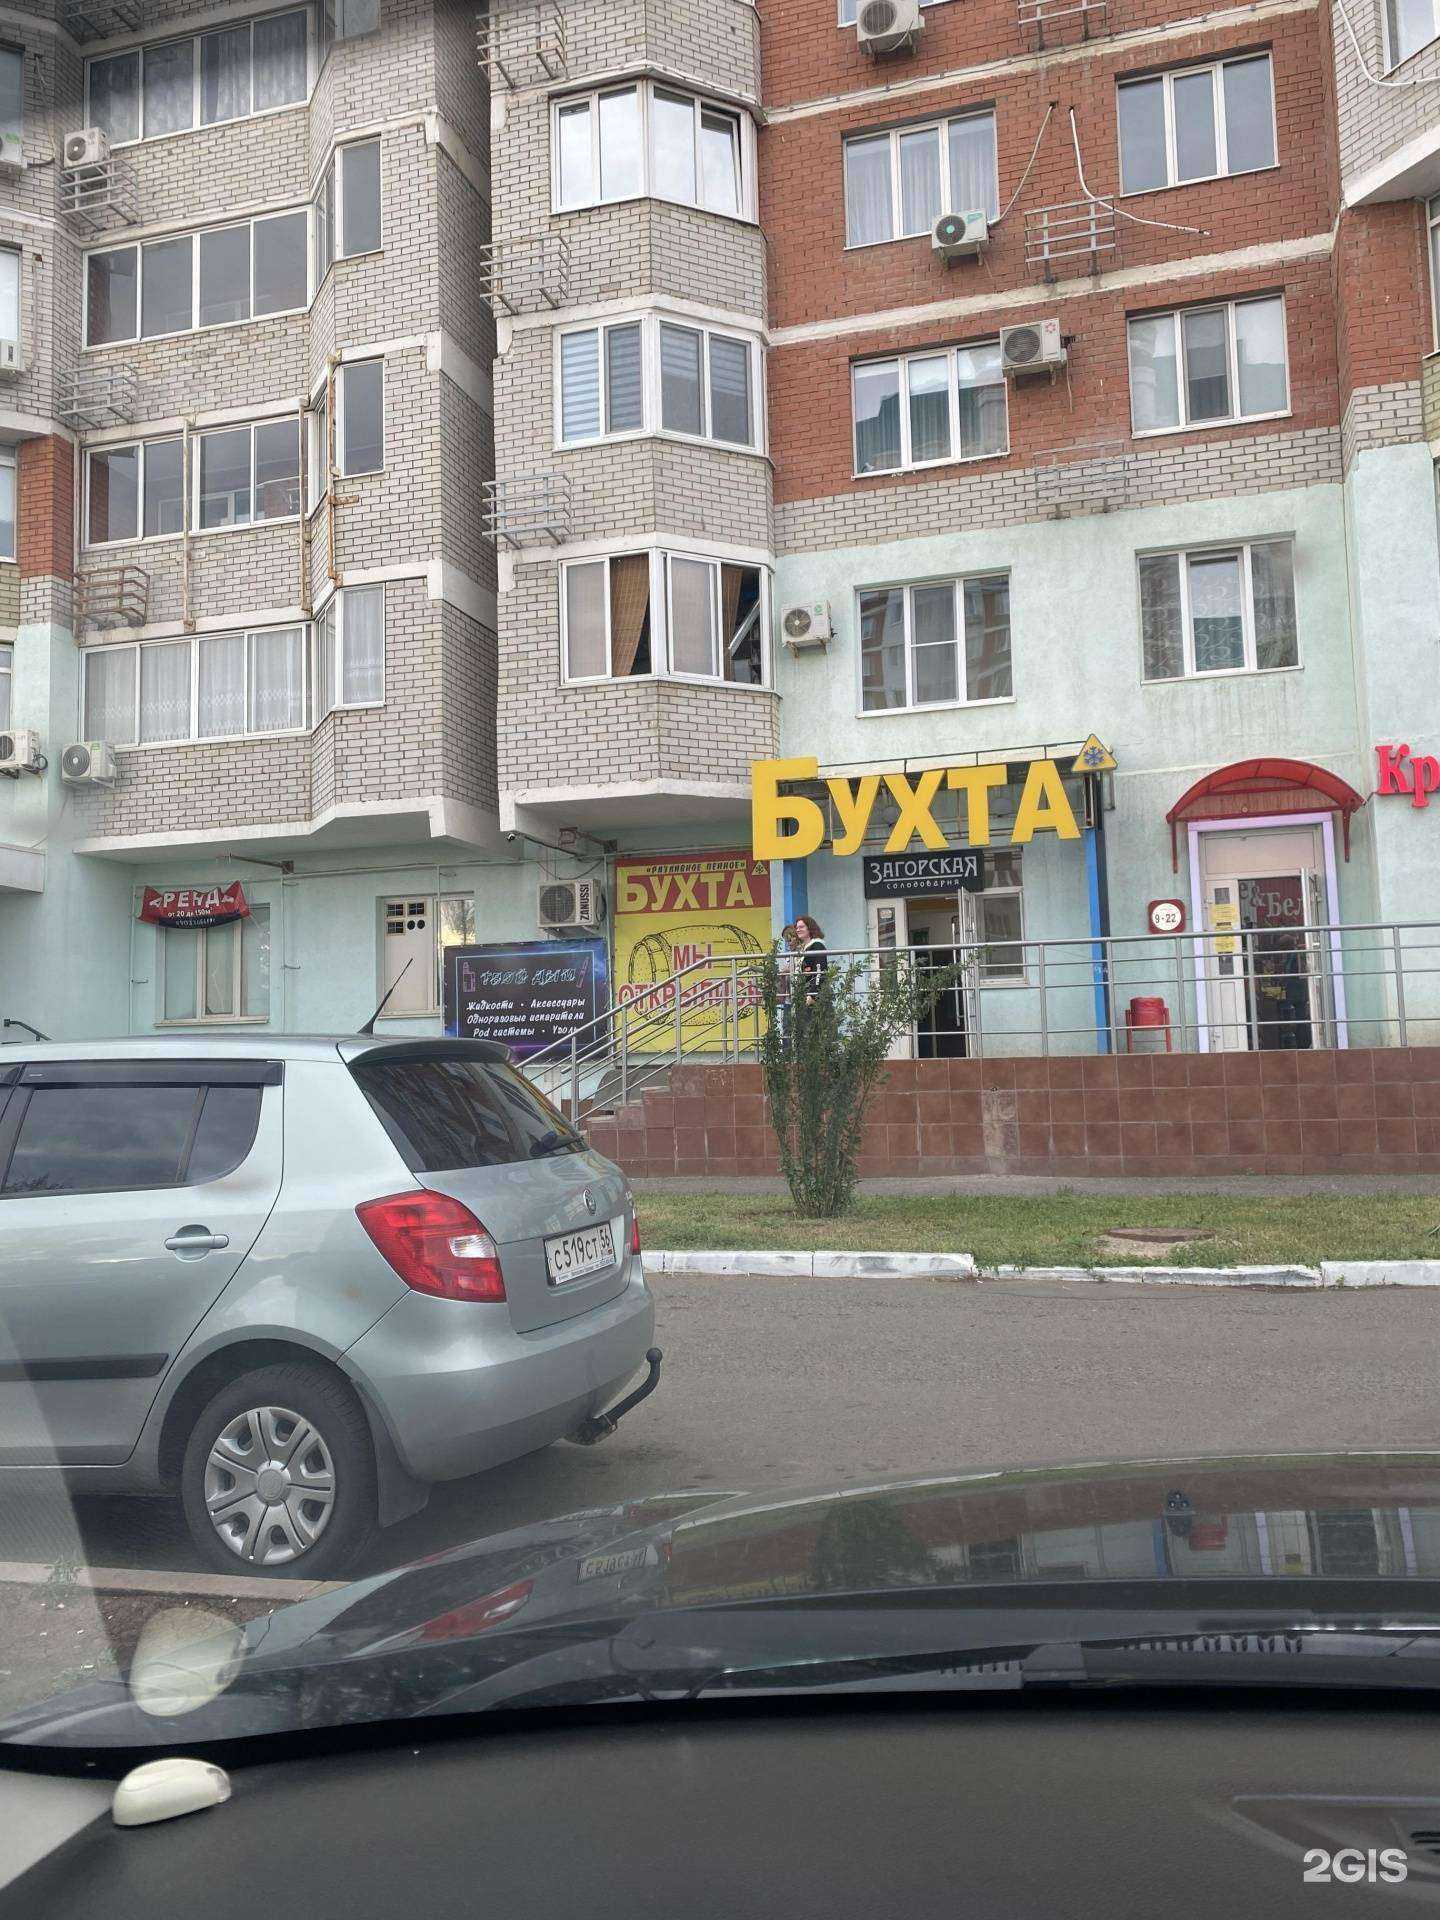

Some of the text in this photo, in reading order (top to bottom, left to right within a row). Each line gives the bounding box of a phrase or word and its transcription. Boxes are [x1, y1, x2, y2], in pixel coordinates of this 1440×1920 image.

[752, 756, 1081, 861] БУХТА
[869, 856, 978, 885] ЗАГОРСКАЯ
[616, 866, 754, 913] БУХТА
[886, 880, 960, 890] солодоварня
[580, 884, 589, 921] ZANUSSI
[673, 943, 712, 971] МЫ
[466, 998, 585, 1011] Жидкости Аксессуары
[466, 1011, 584, 1025] Одноразовые испарители
[473, 1027, 490, 1037] Pod
[493, 1026, 535, 1036] системы
